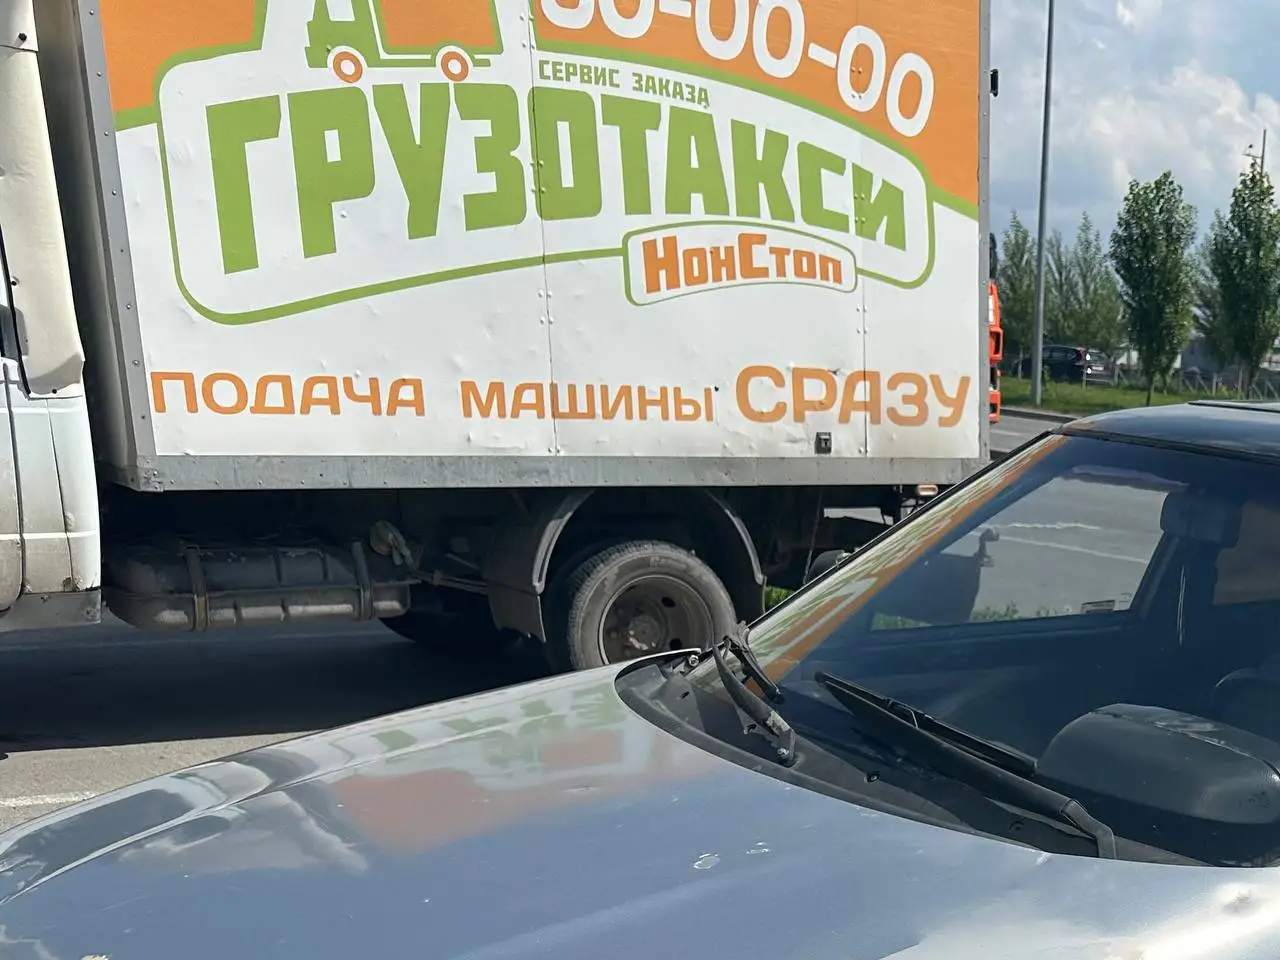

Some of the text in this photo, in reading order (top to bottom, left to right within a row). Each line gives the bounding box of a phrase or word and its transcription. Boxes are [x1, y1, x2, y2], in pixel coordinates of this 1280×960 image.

[538, 59, 710, 107] СЕРВИС ЗАКАЗА
[205, 82, 907, 275] ГРУЗОТАКСИ
[150, 364, 971, 429] ПОДАЧА МАШИНЫ СРАЗУ
